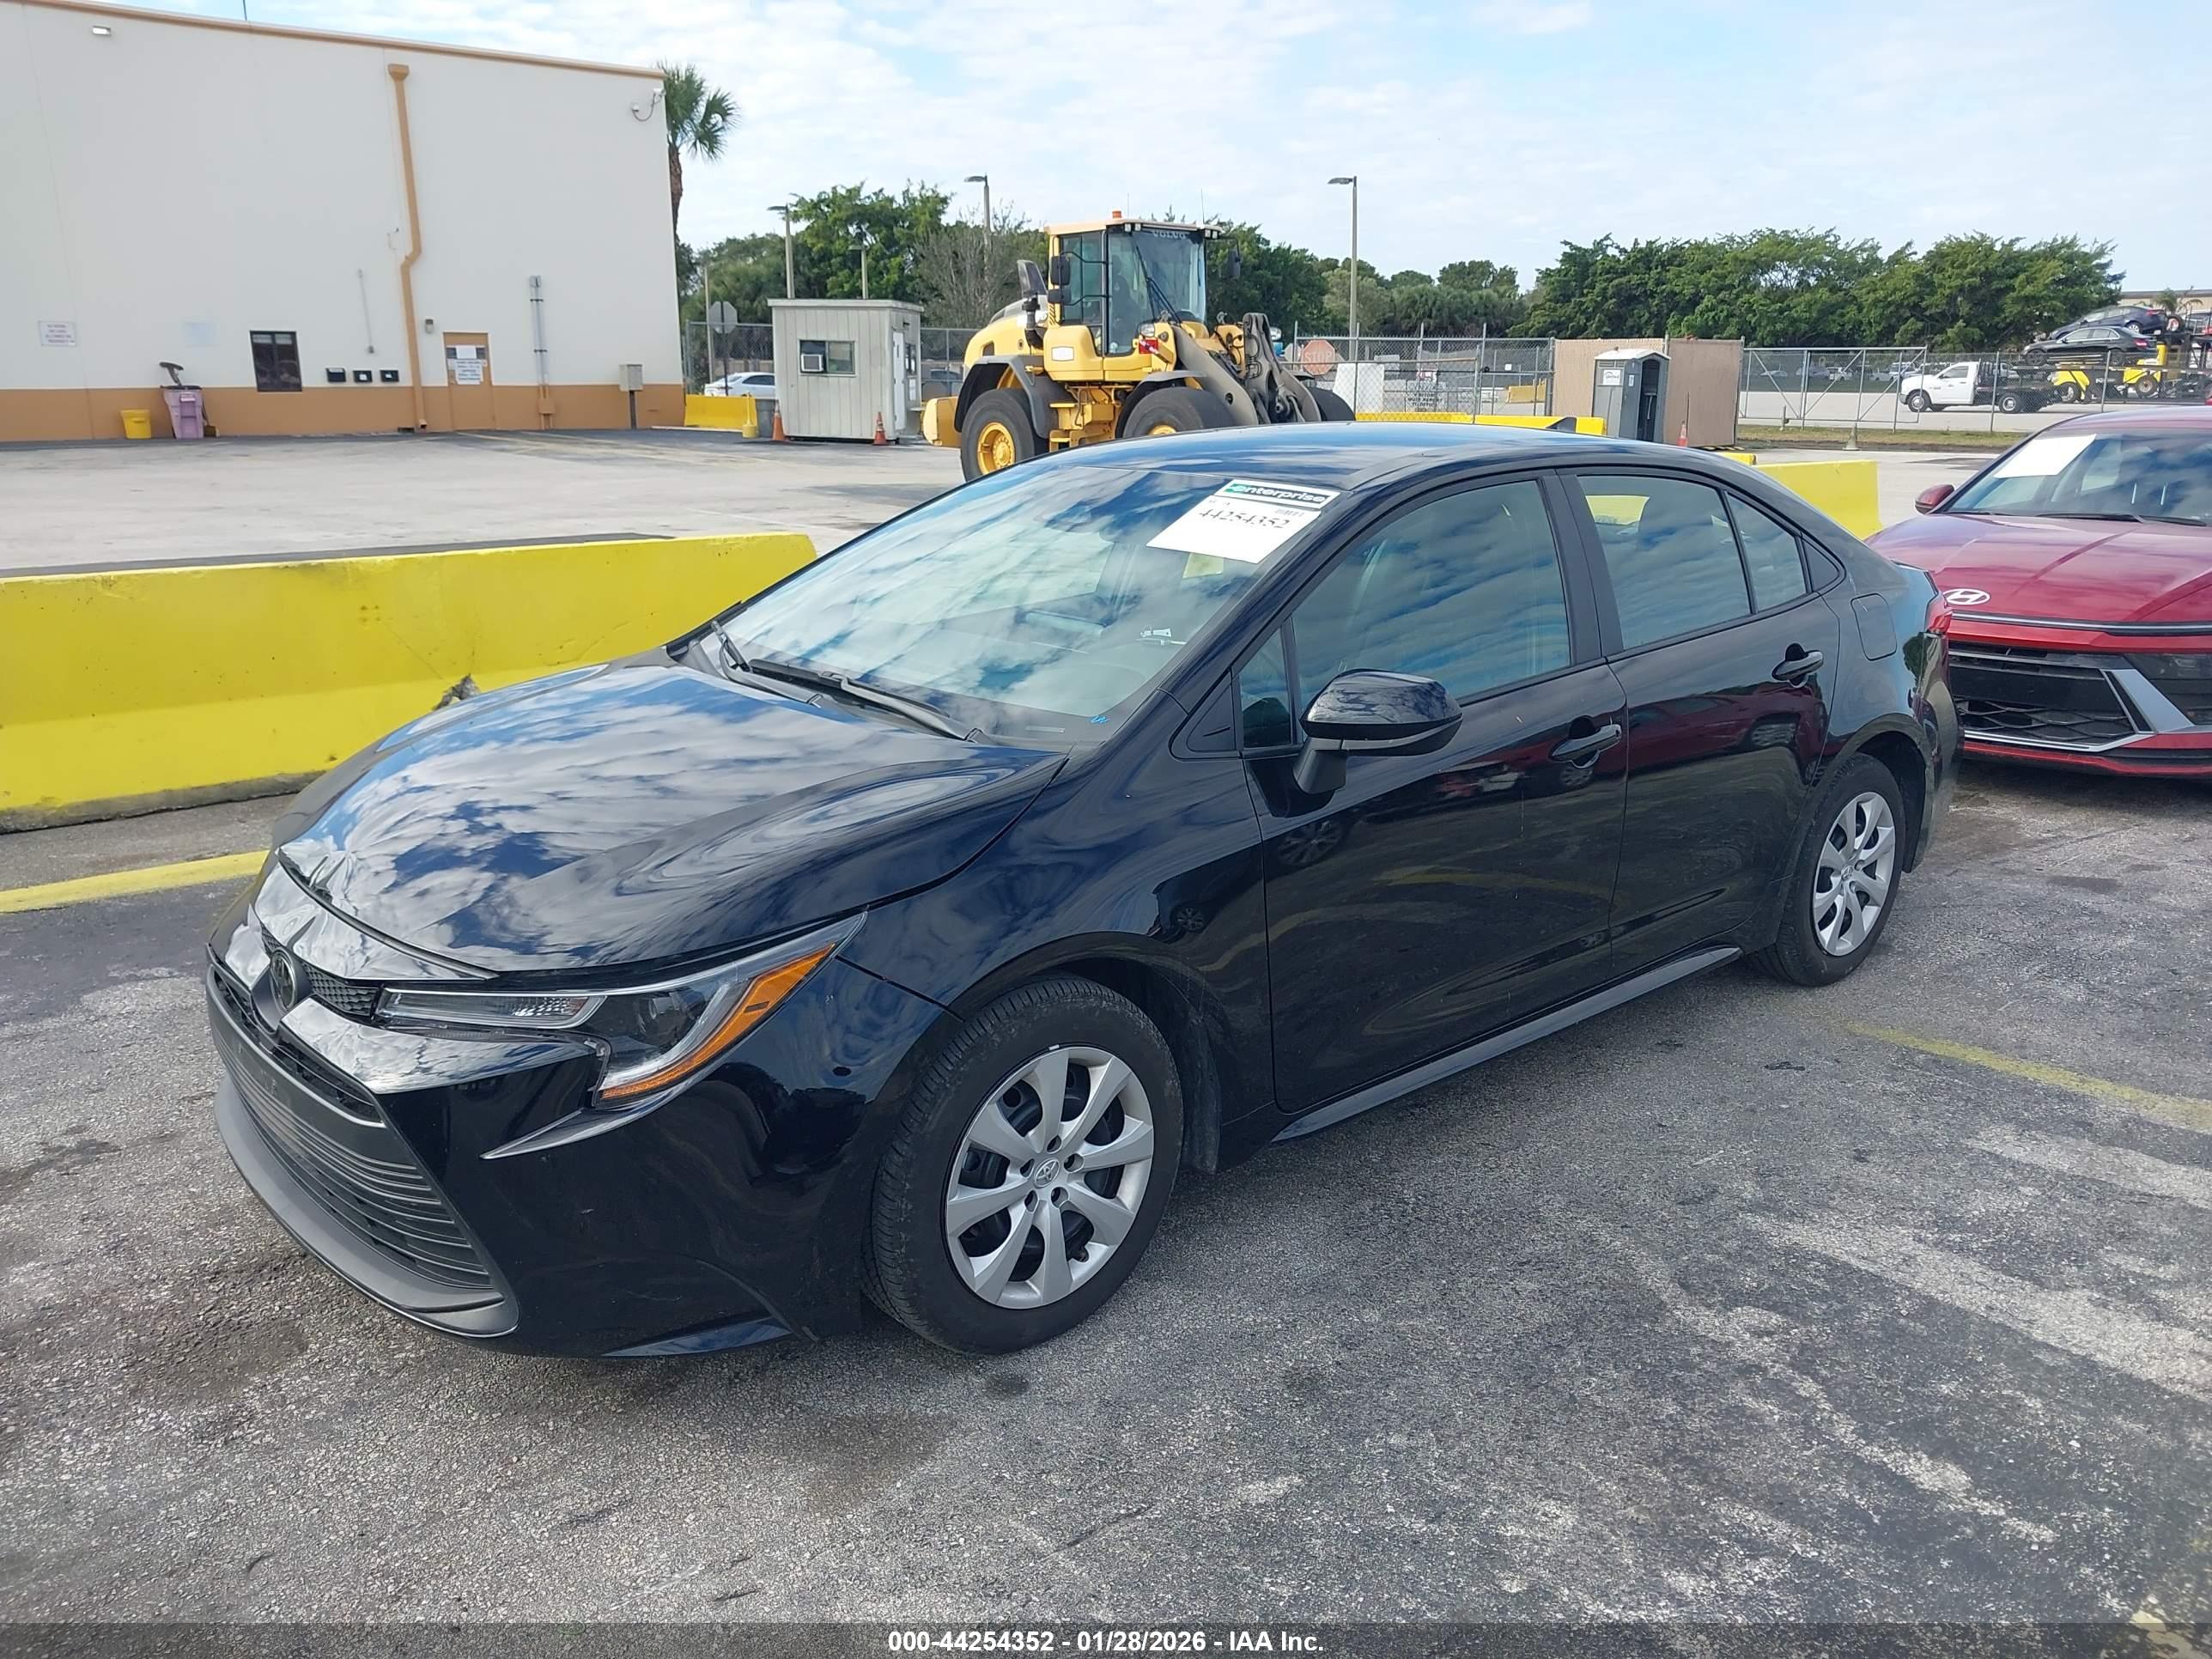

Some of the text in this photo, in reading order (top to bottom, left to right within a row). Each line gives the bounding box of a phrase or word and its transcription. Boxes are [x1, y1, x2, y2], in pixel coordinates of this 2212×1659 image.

[1153, 230, 1186, 240] VOLVO
[1304, 350, 1333, 362] STOP
[1231, 484, 1327, 502] enterprise
[1199, 508, 1291, 528] 44254352
